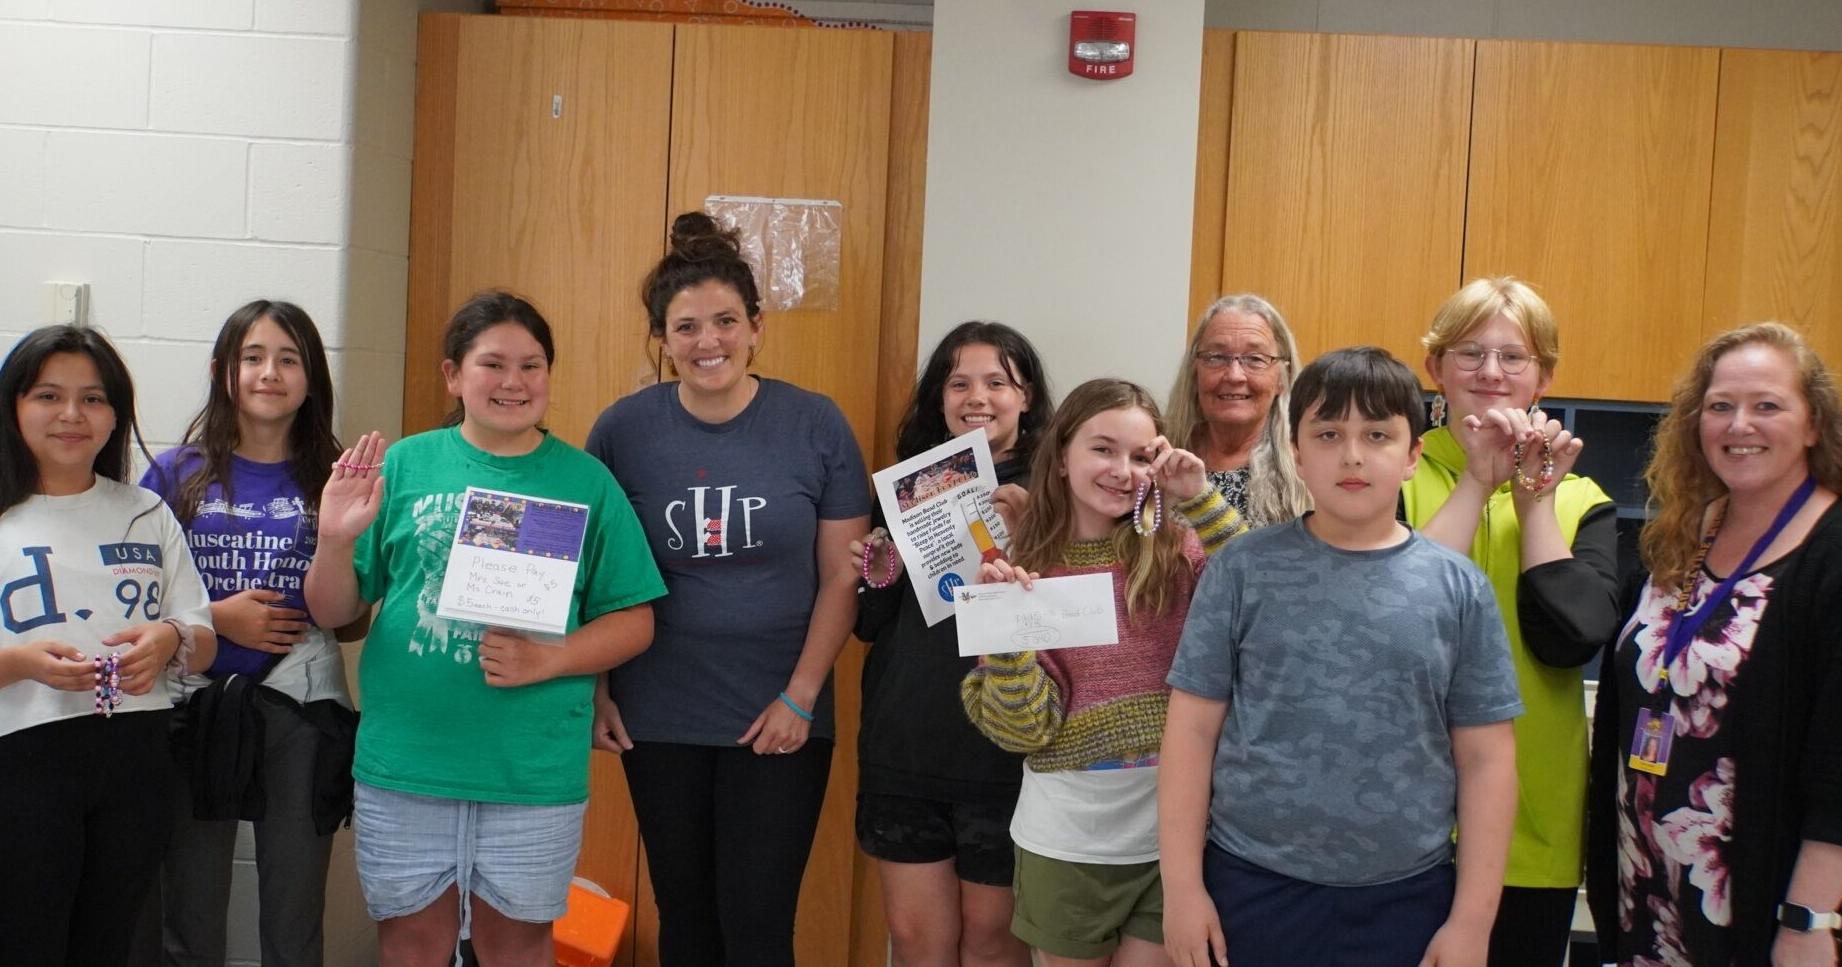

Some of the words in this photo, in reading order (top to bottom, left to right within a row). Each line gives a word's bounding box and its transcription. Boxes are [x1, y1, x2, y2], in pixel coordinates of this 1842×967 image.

[1086, 65, 1116, 74] FIRE
[901, 512, 922, 524] Madison
[922, 505, 936, 515] Bead
[936, 499, 948, 508] Club
[914, 514, 931, 527] selling
[930, 508, 943, 517] their
[906, 522, 931, 537] handmade
[932, 512, 951, 526] jewelry
[933, 524, 955, 538] Heavenly
[917, 530, 929, 540] raise
[941, 532, 954, 542] local
[115, 547, 156, 562] USA
[921, 554, 941, 569] provides
[951, 543, 963, 551] beds
[923, 544, 945, 559] nonprofit
[945, 538, 955, 547] that
[194, 550, 246, 571] outh
[253, 551, 313, 572] Hono
[472, 556, 517, 574] Please
[526, 563, 546, 581] Pay
[934, 556, 953, 568] bedding
[200, 571, 301, 591] Orchetra
[928, 566, 947, 579] children
[116, 579, 160, 621] 98
